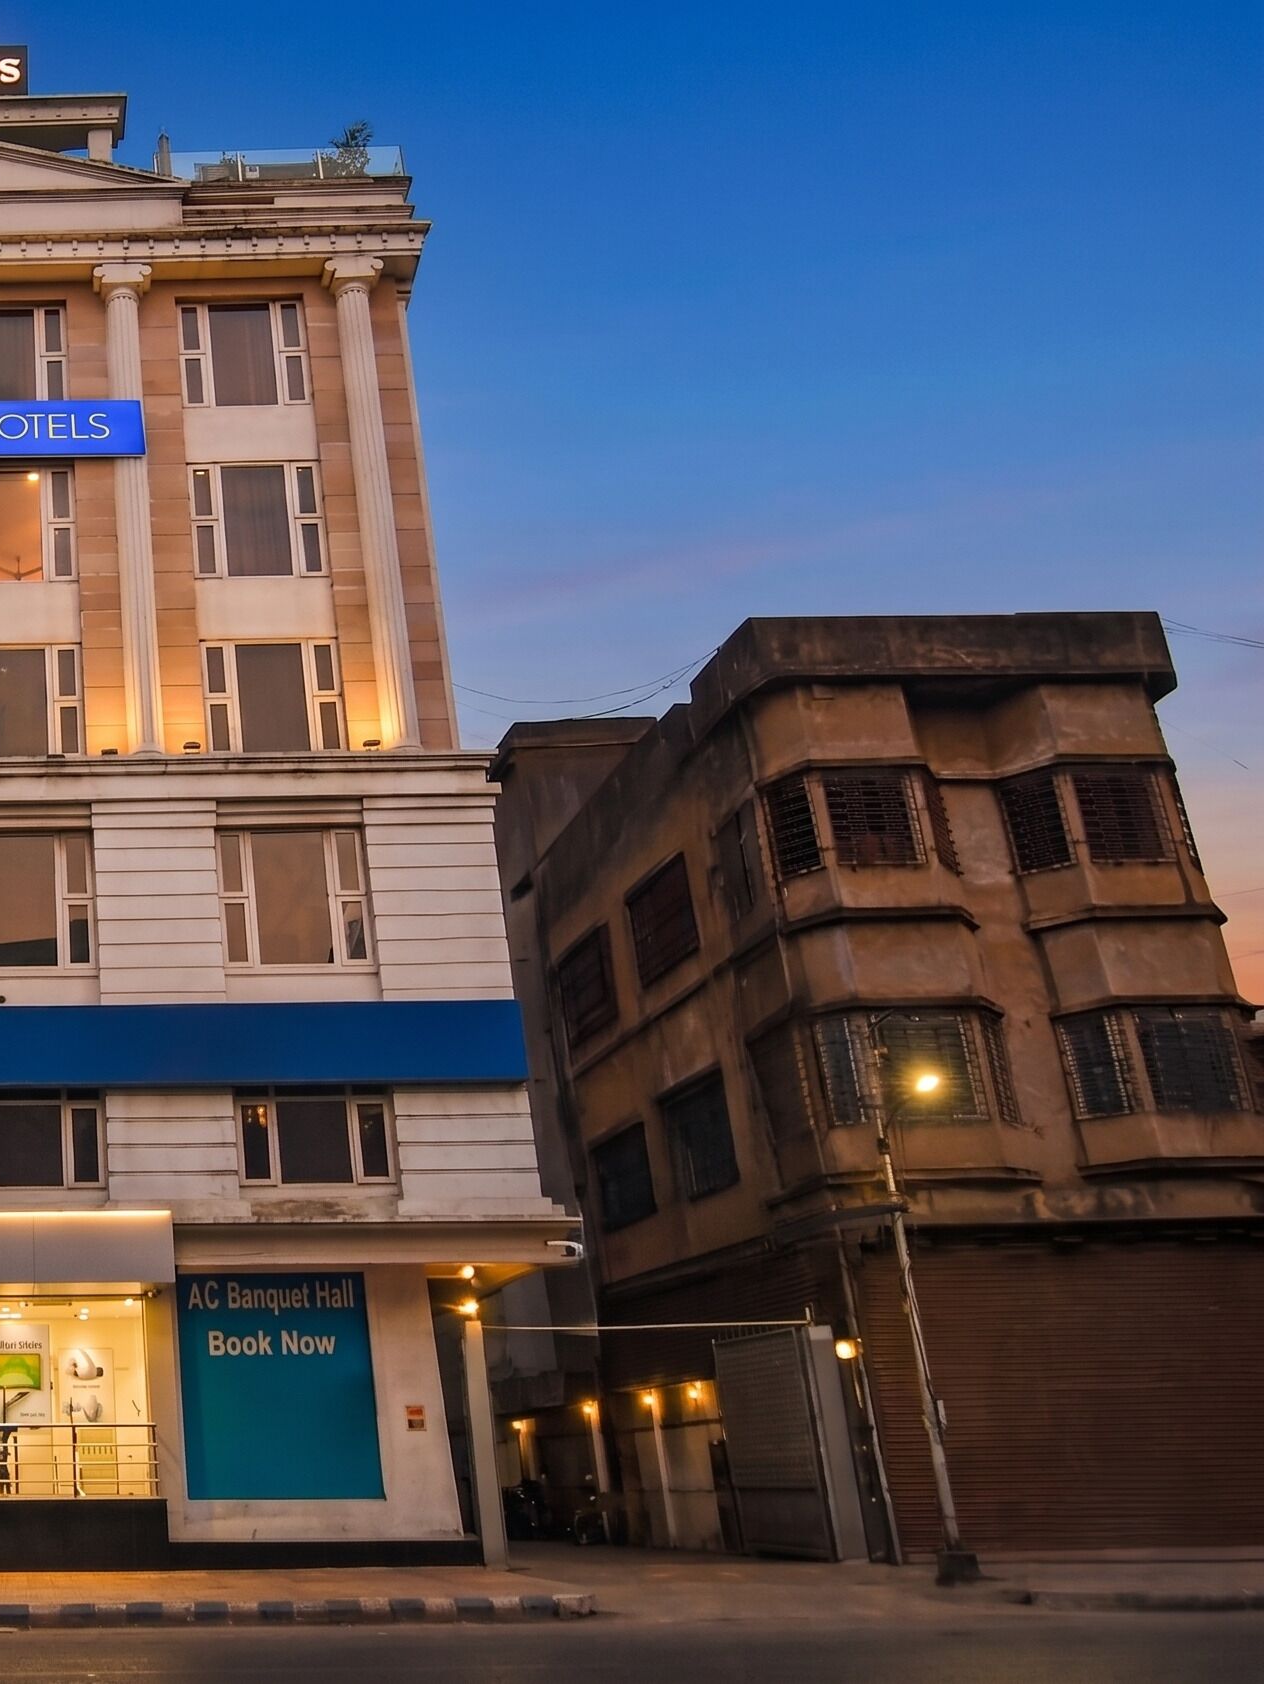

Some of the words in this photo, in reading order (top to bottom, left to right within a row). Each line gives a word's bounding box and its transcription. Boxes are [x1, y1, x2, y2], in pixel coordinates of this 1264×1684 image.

[188, 1280, 219, 1310] AC
[227, 1281, 310, 1316] Banquet
[315, 1279, 354, 1309] Hall
[208, 1330, 273, 1356] Book
[281, 1330, 336, 1356] Now
